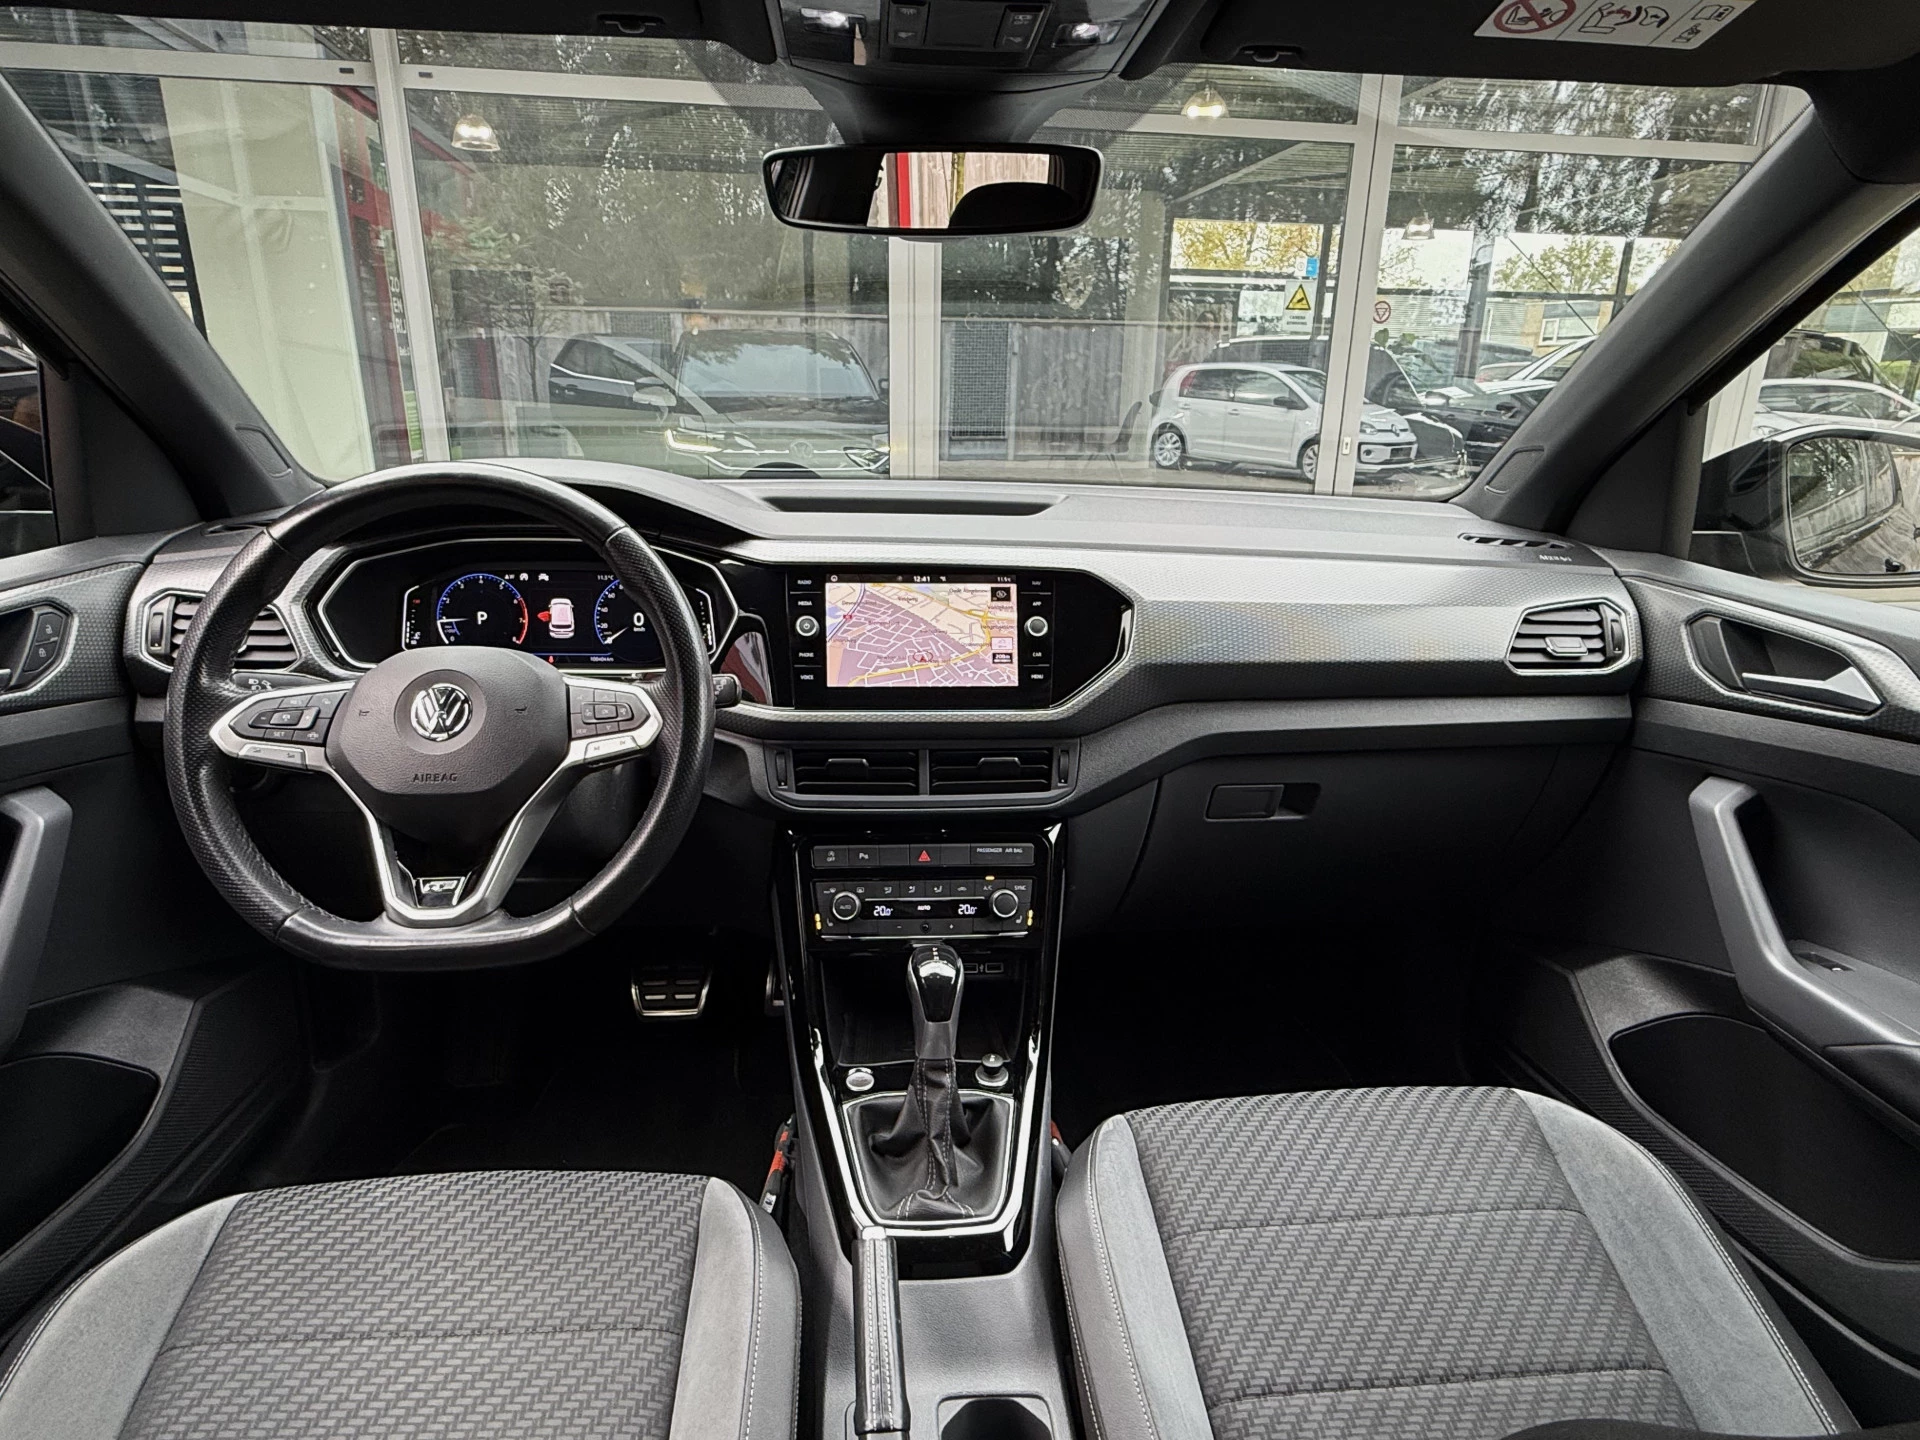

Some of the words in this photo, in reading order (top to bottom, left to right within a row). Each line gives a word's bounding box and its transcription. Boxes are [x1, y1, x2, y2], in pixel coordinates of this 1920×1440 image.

[477, 611, 488, 624] P
[633, 612, 644, 626] 0
[412, 773, 458, 783] AIRBAG
